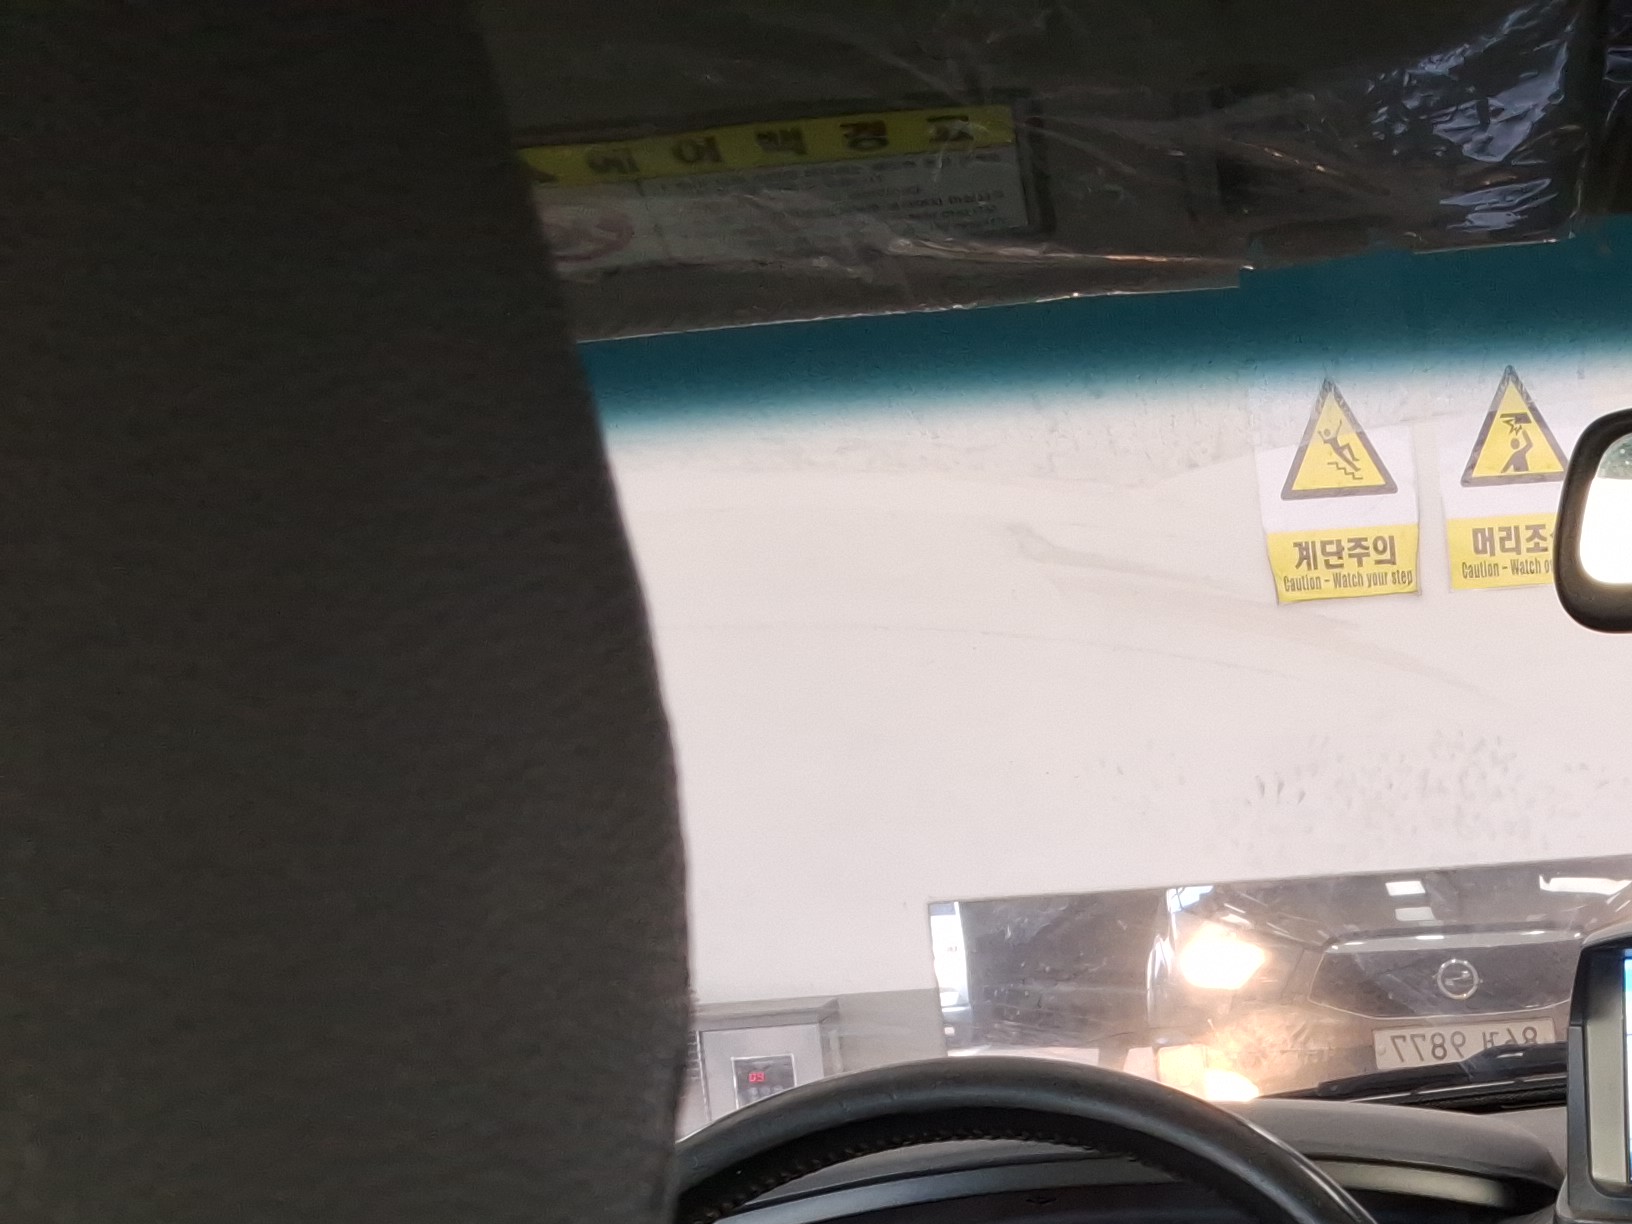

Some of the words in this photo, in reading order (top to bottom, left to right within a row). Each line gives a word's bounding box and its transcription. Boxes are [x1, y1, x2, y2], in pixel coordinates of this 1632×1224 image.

[1293, 535, 1397, 571] 계단주의
[1283, 574, 1322, 592] Caution
[1333, 572, 1364, 589] Watch
[1367, 571, 1389, 589] your
[1391, 568, 1413, 588] step
[1462, 558, 1500, 579] Caution
[1510, 557, 1542, 576] Watch
